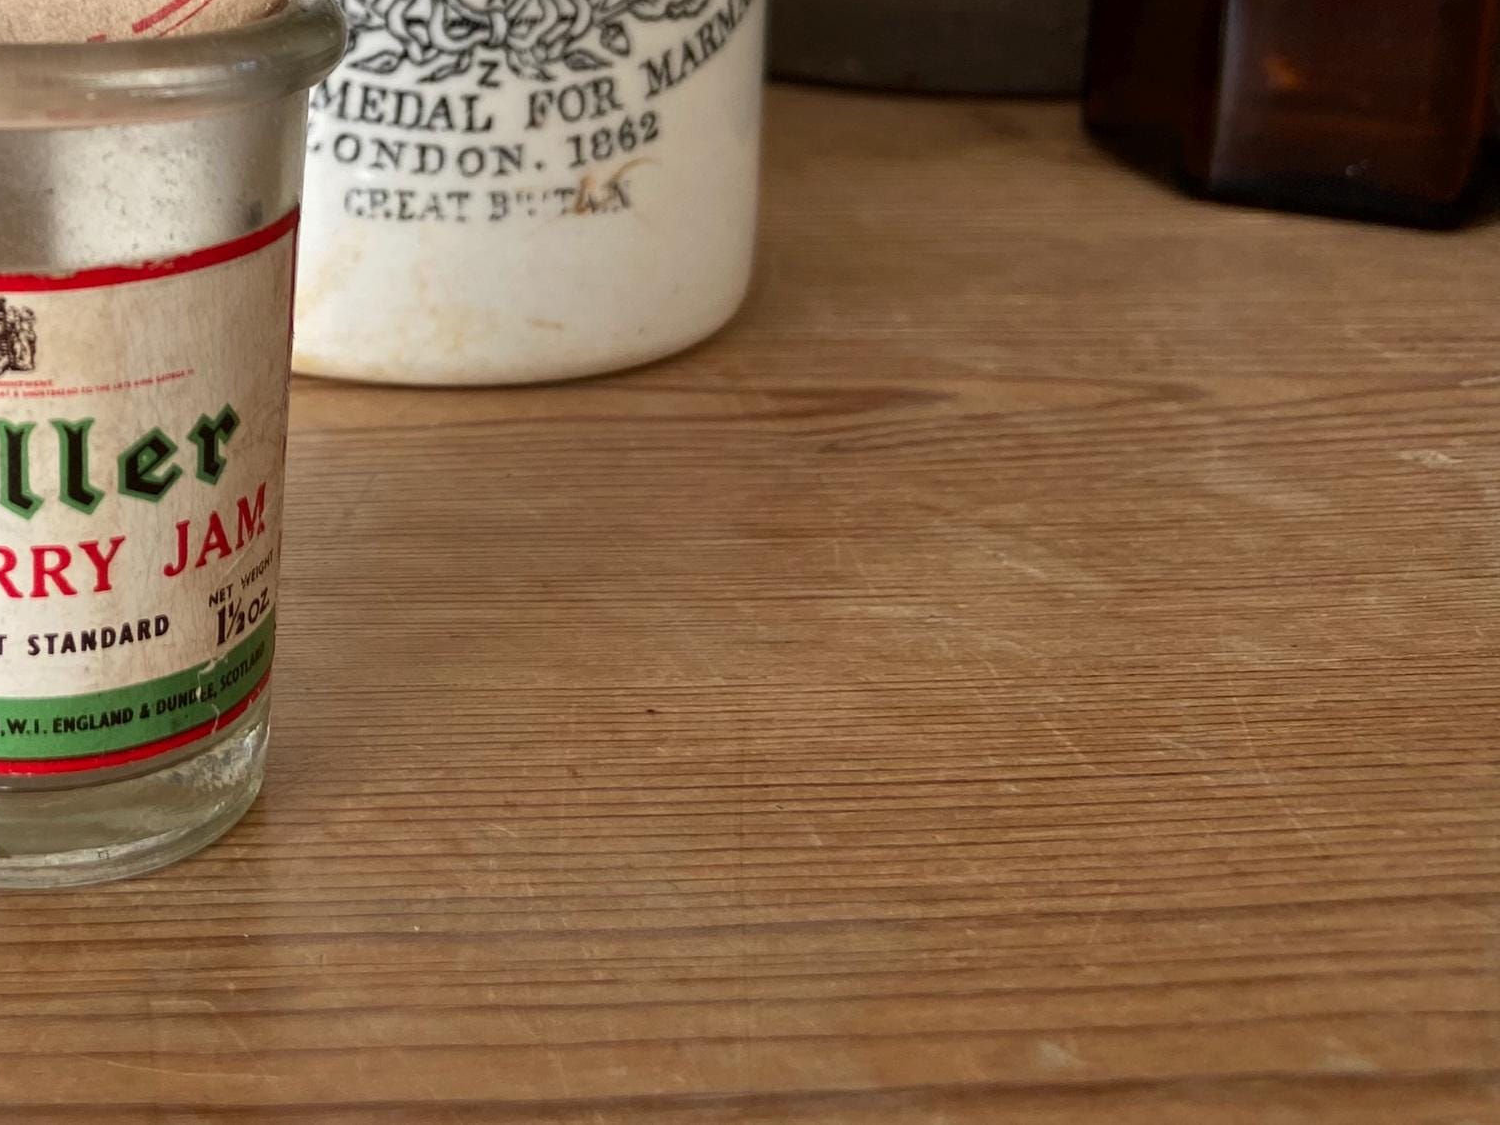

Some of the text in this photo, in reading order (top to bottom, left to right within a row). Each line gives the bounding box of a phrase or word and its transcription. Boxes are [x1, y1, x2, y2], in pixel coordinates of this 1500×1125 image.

[525, 76, 624, 131] FOR
[312, 110, 661, 178] ONDON. 1862
[163, 481, 268, 577] JAM
[208, 548, 274, 607] NET WEIGHT
[27, 613, 171, 656] STANDARD
[52, 706, 134, 734] ENGLAND
[139, 702, 151, 720] &
